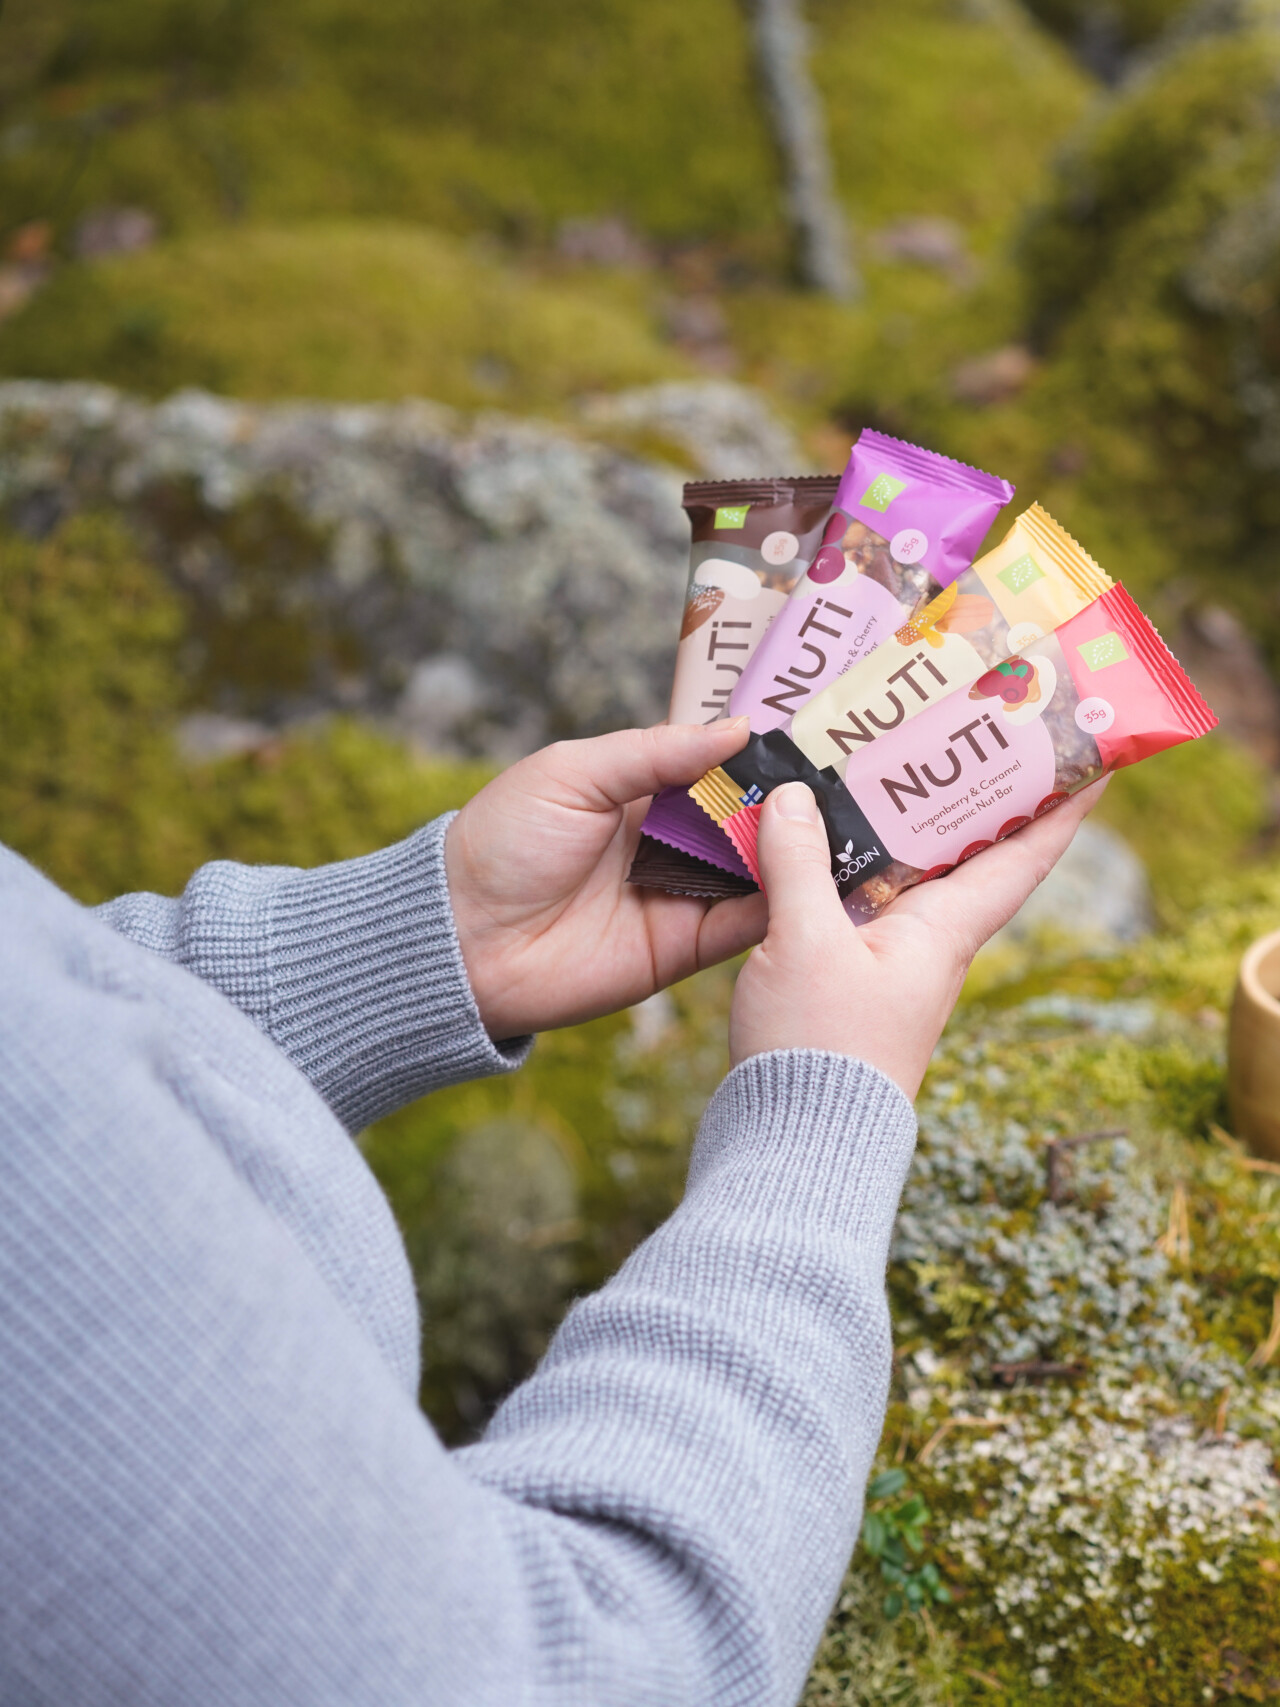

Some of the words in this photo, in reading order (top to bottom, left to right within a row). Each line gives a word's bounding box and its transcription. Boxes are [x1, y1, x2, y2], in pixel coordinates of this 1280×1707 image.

[773, 537, 789, 557] 35g
[900, 537, 920, 556] 35g
[848, 649, 860, 658] &
[854, 615, 878, 647] Cherry
[1083, 708, 1107, 724] 35g
[911, 793, 970, 835] Lingonberry
[969, 785, 981, 798] &
[980, 760, 1023, 791] Caramel
[936, 808, 978, 836] Organic
[977, 796, 997, 812] Nut
[995, 783, 1014, 799] Bar
